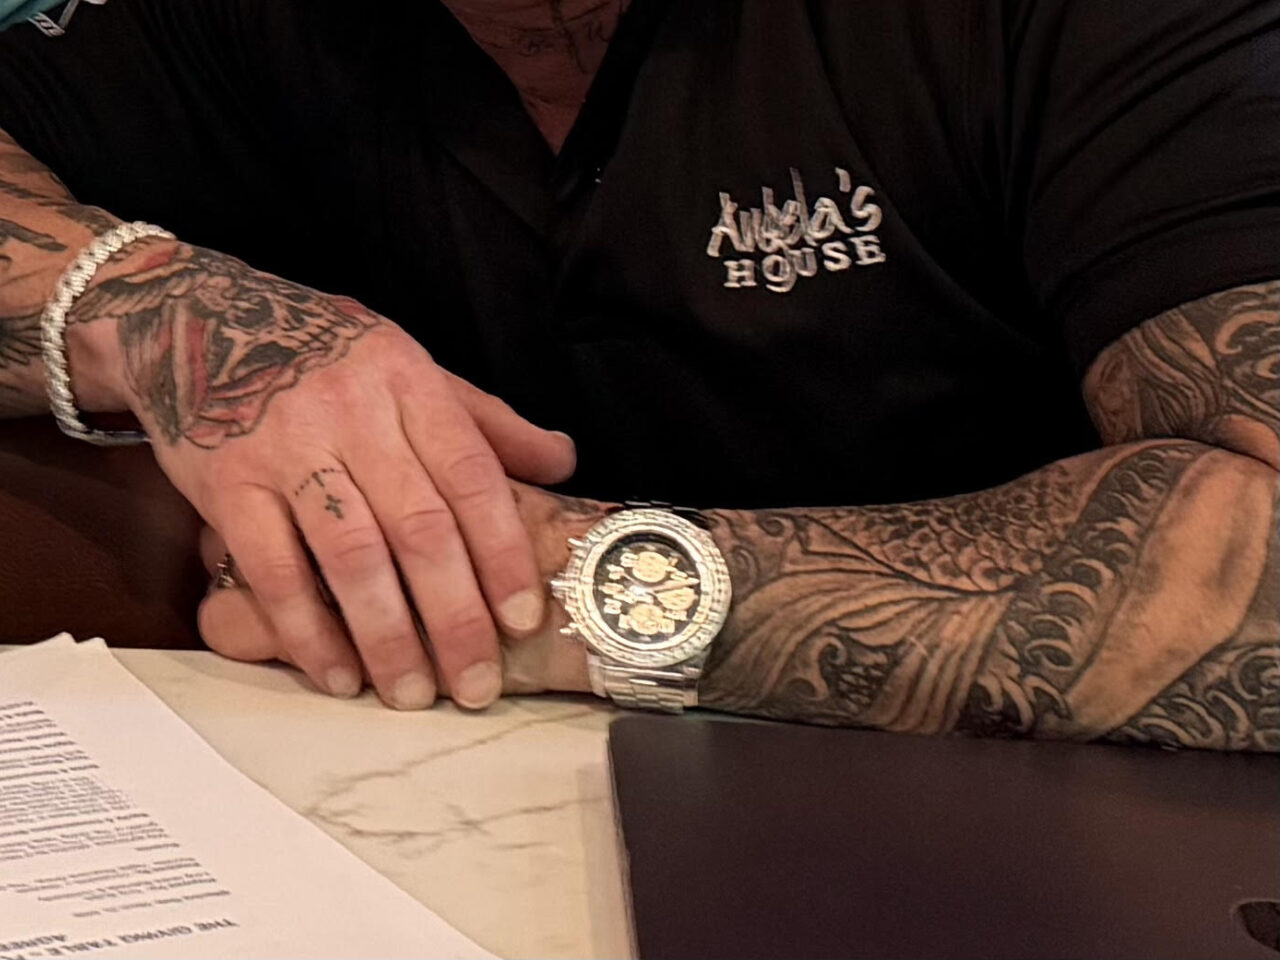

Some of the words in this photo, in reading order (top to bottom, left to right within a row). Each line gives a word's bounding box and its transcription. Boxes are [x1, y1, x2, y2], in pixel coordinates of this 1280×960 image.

[722, 234, 887, 293] HOUSE
[193, 918, 240, 930] THE
[116, 926, 192, 945] GIVING
[47, 938, 117, 957] TABLE
